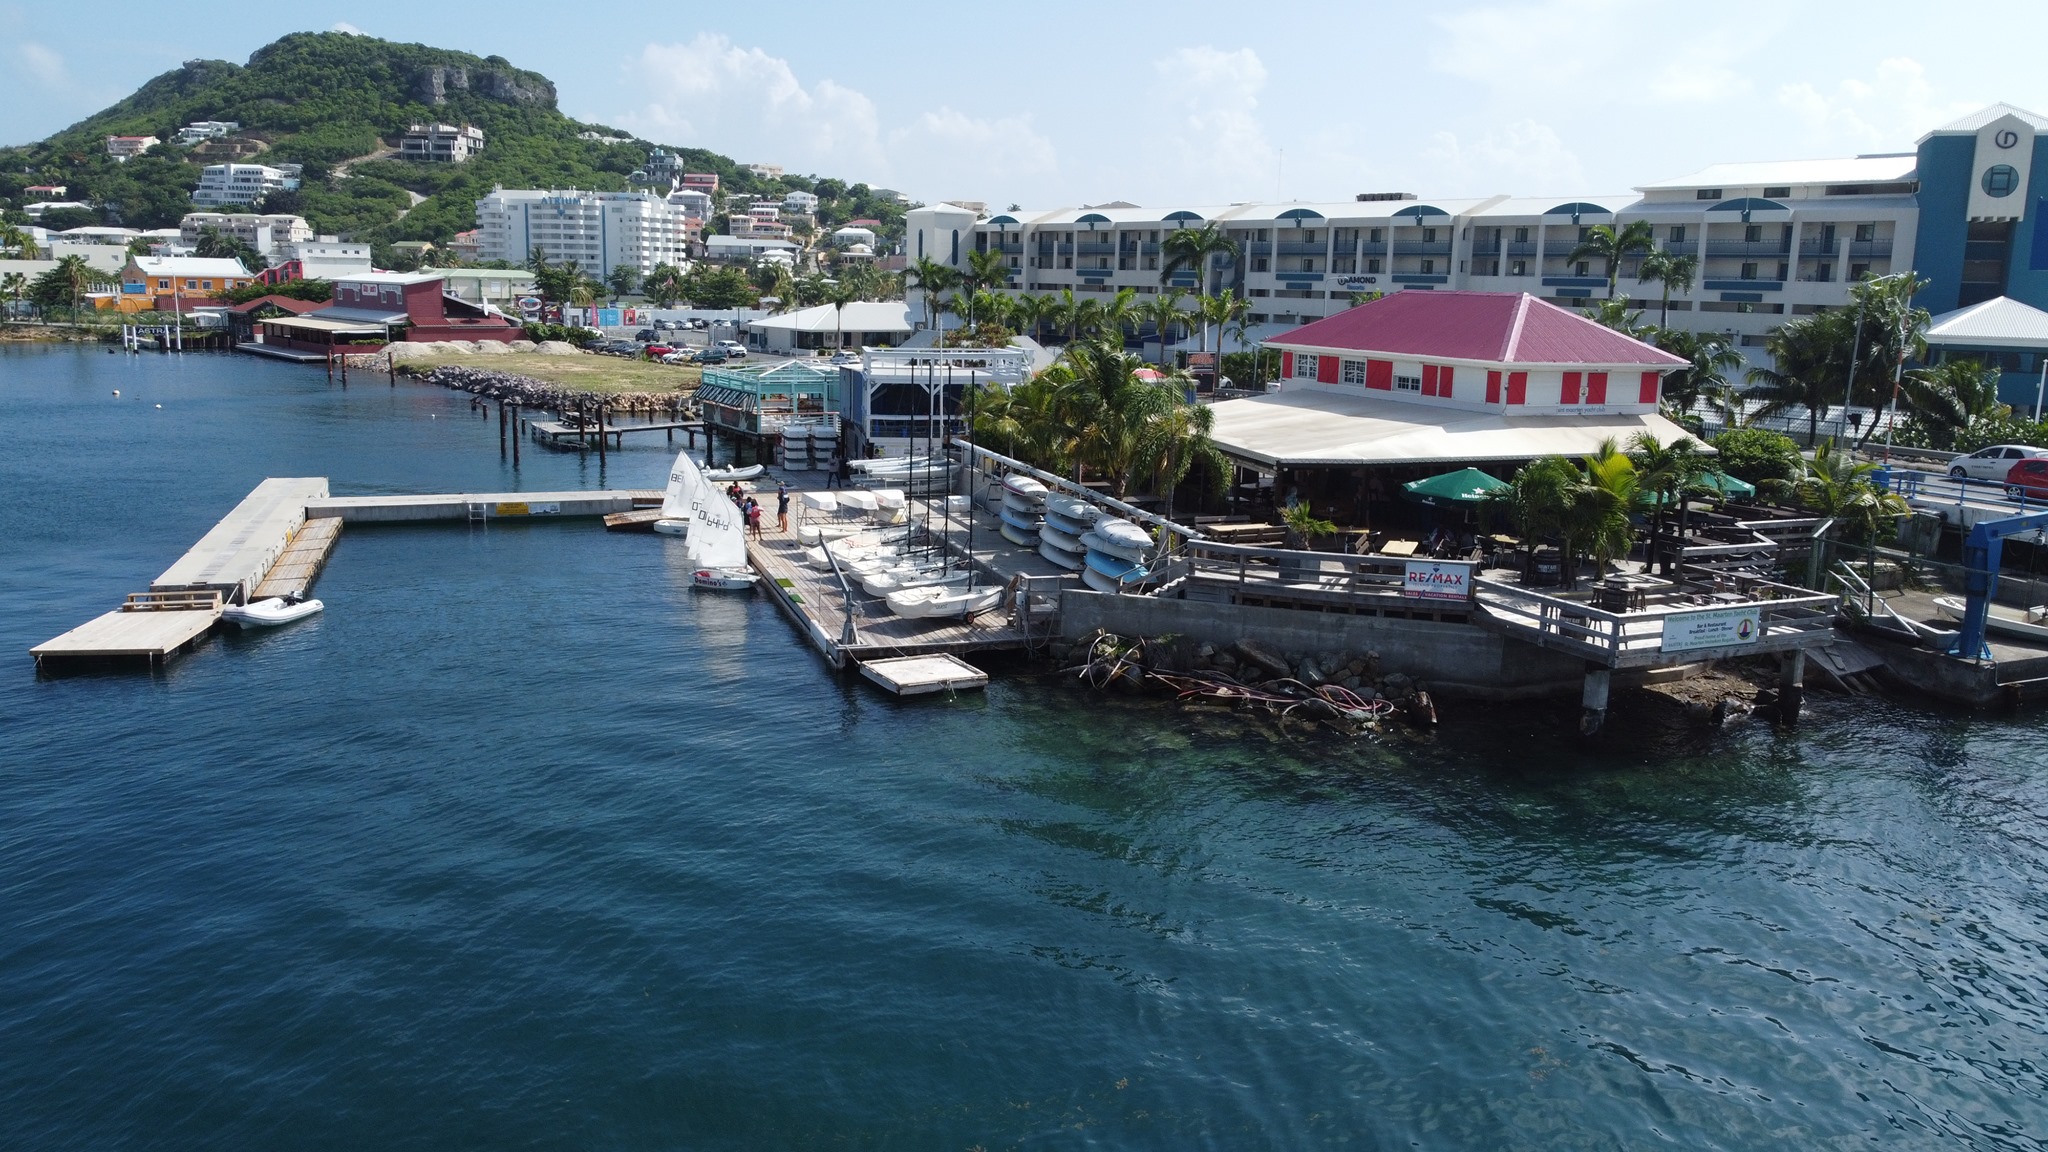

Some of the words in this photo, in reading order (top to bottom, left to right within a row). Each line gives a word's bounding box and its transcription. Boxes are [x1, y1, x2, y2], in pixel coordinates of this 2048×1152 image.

[542, 197, 582, 205] ATRIUM
[695, 577, 721, 586] Domino's
[1409, 572, 1462, 585] RE/MAX
